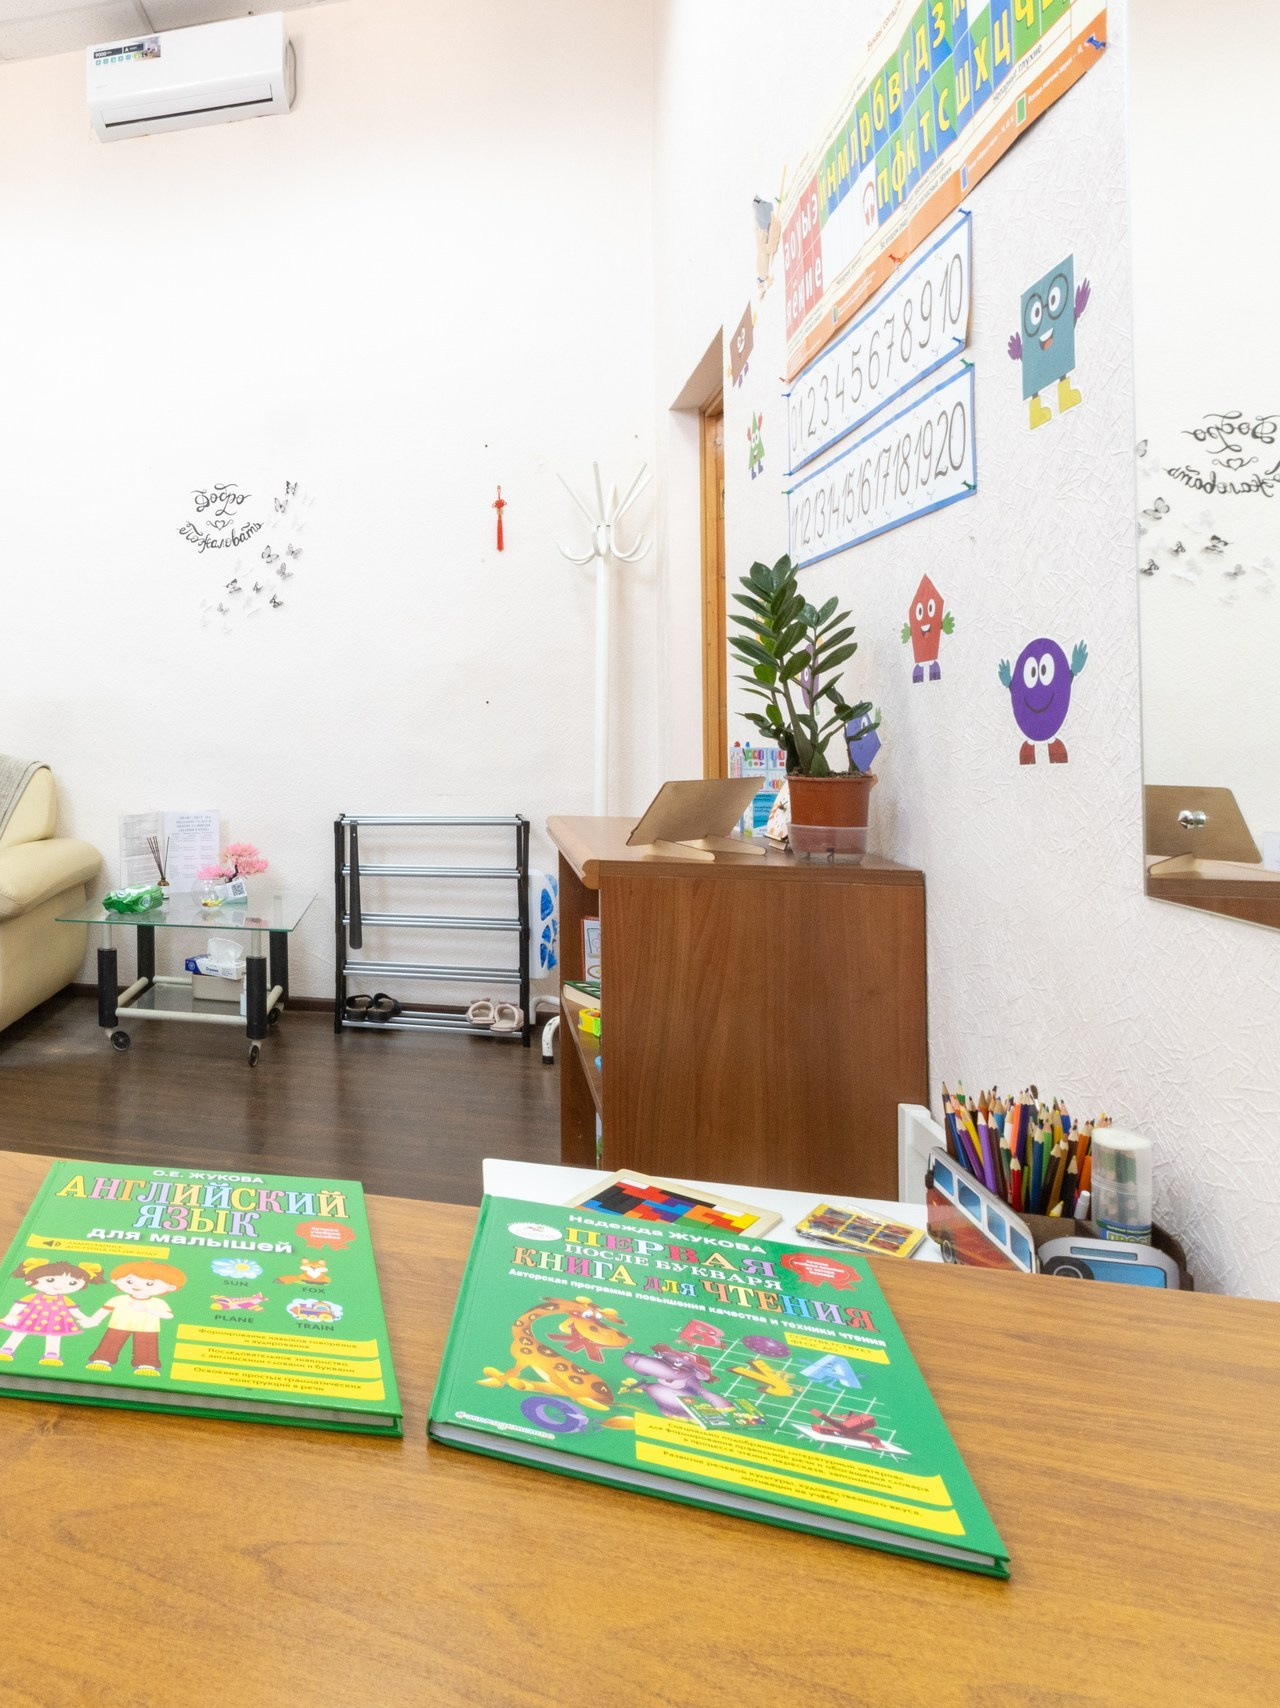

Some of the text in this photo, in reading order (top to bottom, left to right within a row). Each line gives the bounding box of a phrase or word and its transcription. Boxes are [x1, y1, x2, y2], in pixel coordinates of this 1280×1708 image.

[808, 386, 816, 438] 2
[820, 375, 830, 426] 3
[836, 364, 845, 413] 4
[851, 344, 863, 403] 5
[868, 330, 880, 390] 6
[884, 313, 895, 378] 7
[900, 298, 913, 363] 8
[919, 280, 932, 349] 9
[940, 253, 963, 334] 10
[800, 497, 811, 544] 12
[813, 488, 826, 540] 13
[828, 481, 840, 534] 14
[843, 468, 855, 526] 15
[857, 458, 871, 518] 16
[874, 444, 891, 509] 17
[893, 433, 911, 499] 18
[914, 420, 933, 489] 19
[934, 401, 966, 480] 20
[190, 483, 252, 516] Добро
[176, 521, 264, 553] Пожаловать
[189, 1172, 264, 1184] ЖУКОВА
[55, 1175, 349, 1218] АНГЛИЙСКИЙ
[132, 1204, 260, 1238] ЯЗЫК
[569, 1215, 664, 1237] Надежда
[669, 1231, 767, 1254] ЖУКОВА
[87, 1228, 141, 1241] для
[150, 1233, 293, 1254] малышей
[564, 1227, 780, 1279] ПЕРВАЯ
[223, 1279, 249, 1287] SUN
[564, 1243, 649, 1266] ПОСЛЕ
[655, 1259, 783, 1291] БУКВАРЯ
[302, 1287, 326, 1295] FOX
[511, 1246, 637, 1286] КНИГА
[700, 1279, 881, 1333] ЧТЕНИЯ
[214, 1314, 255, 1324] PLANE
[509, 1268, 568, 1286] Авторская
[571, 1280, 633, 1298] программа
[635, 1292, 706, 1312] повышения
[709, 1307, 767, 1324] качества
[781, 1320, 836, 1337] техники
[839, 1331, 887, 1348] чтения
[297, 1322, 335, 1332] TRAIN
